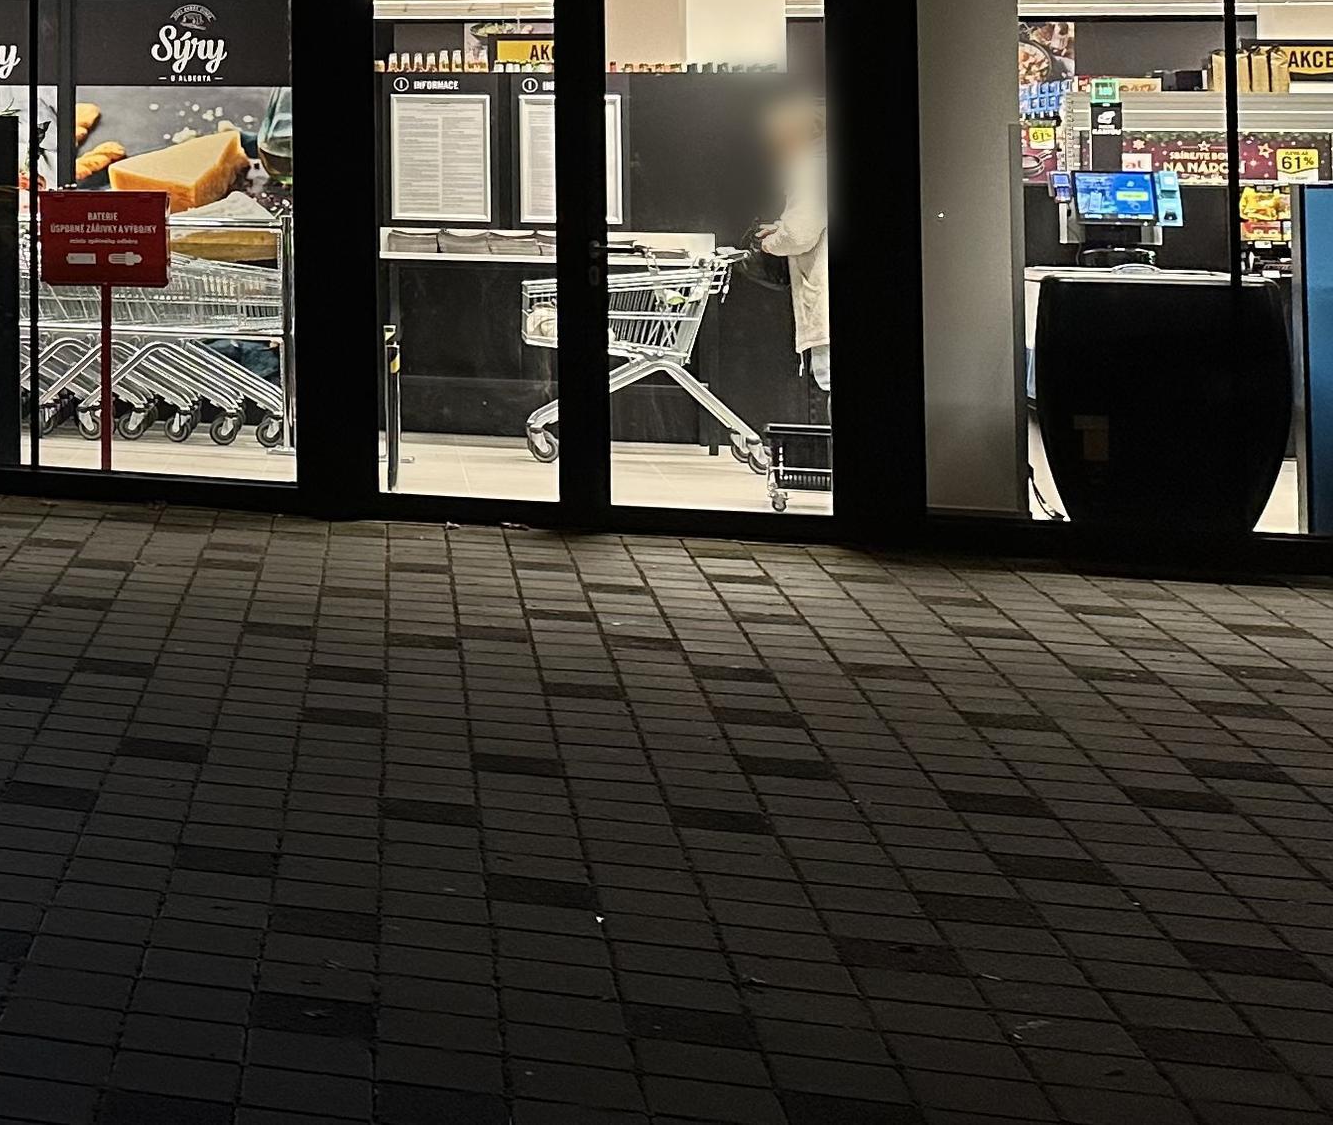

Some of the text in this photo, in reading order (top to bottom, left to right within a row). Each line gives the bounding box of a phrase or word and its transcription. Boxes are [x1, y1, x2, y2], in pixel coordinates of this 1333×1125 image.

[151, 25, 228, 74] Sýry
[413, 80, 459, 90] INFORMACE
[1282, 156, 1314, 170] 61%
[87, 211, 118, 221] BATERIE
